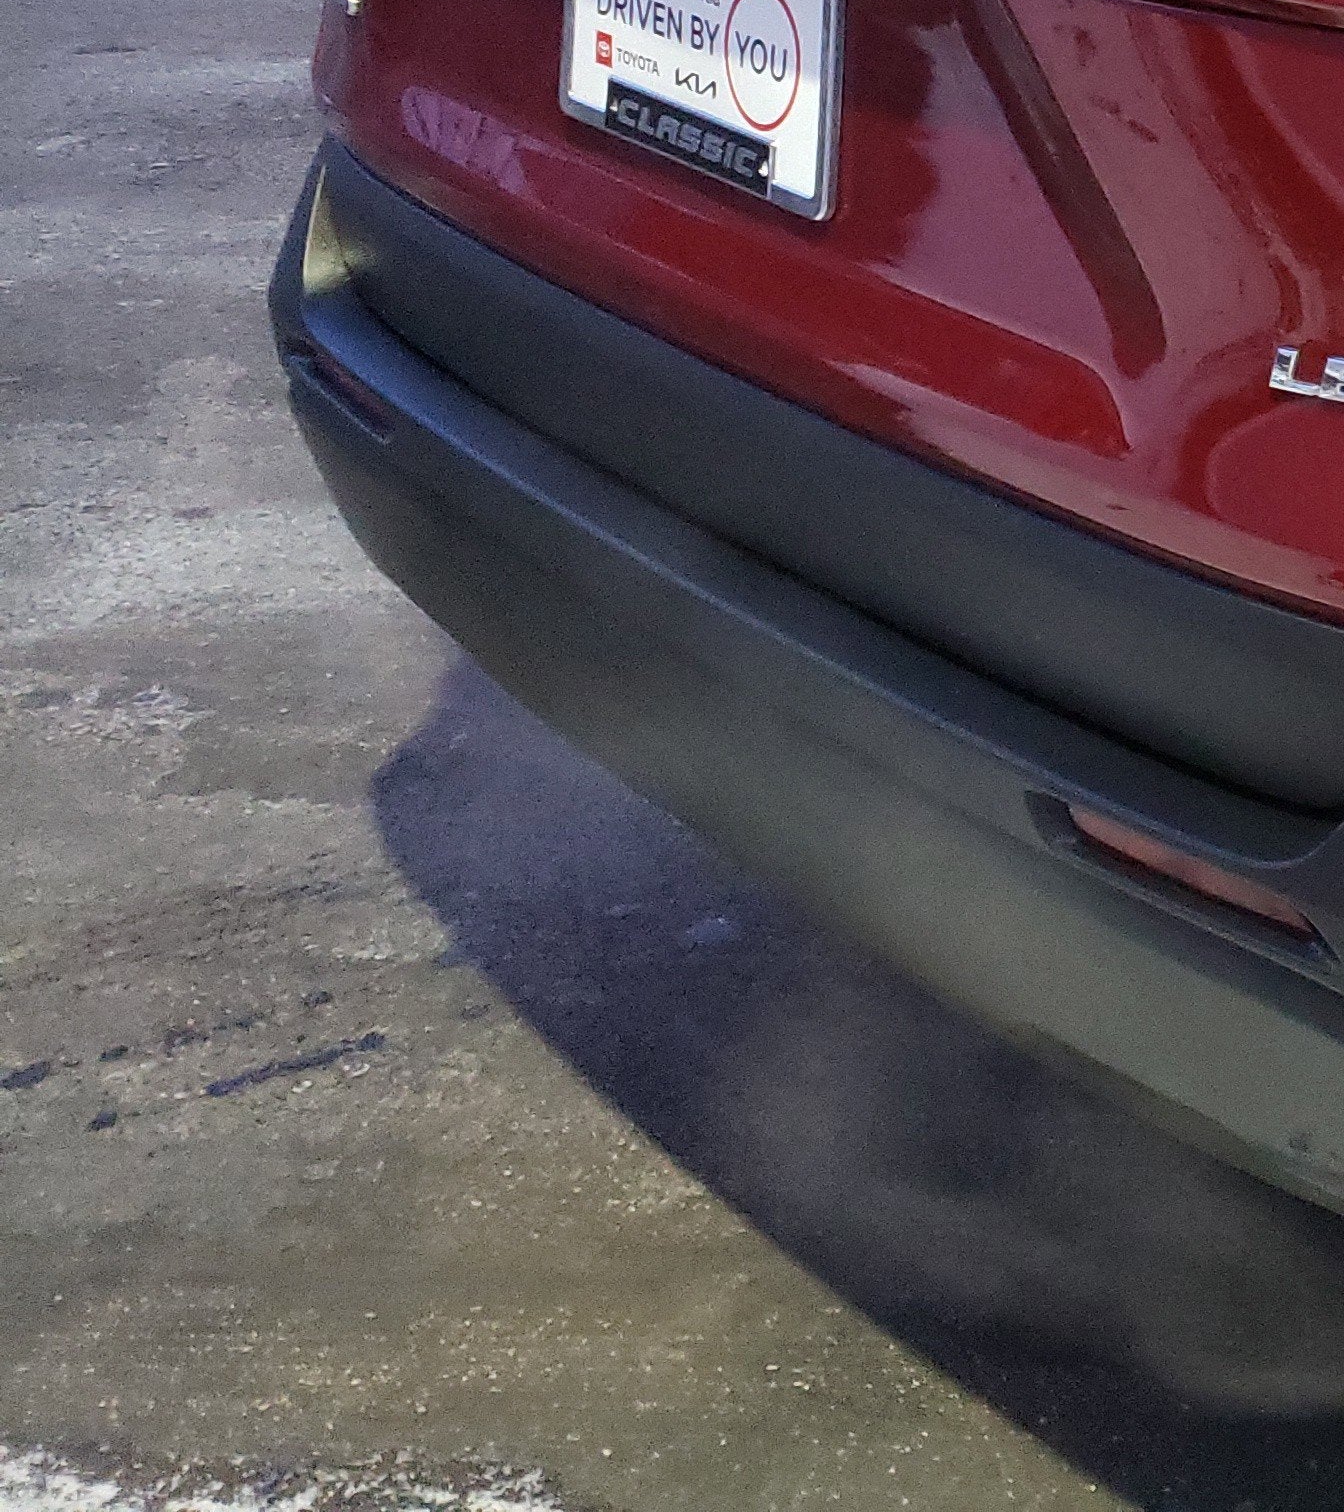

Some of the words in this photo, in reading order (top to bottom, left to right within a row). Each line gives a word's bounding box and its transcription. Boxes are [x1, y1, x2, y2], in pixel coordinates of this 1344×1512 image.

[616, 47, 660, 77] TOYOTA
[690, 13, 721, 56] BY
[735, 30, 788, 83] YOU
[616, 98, 759, 179] CLASSIC
